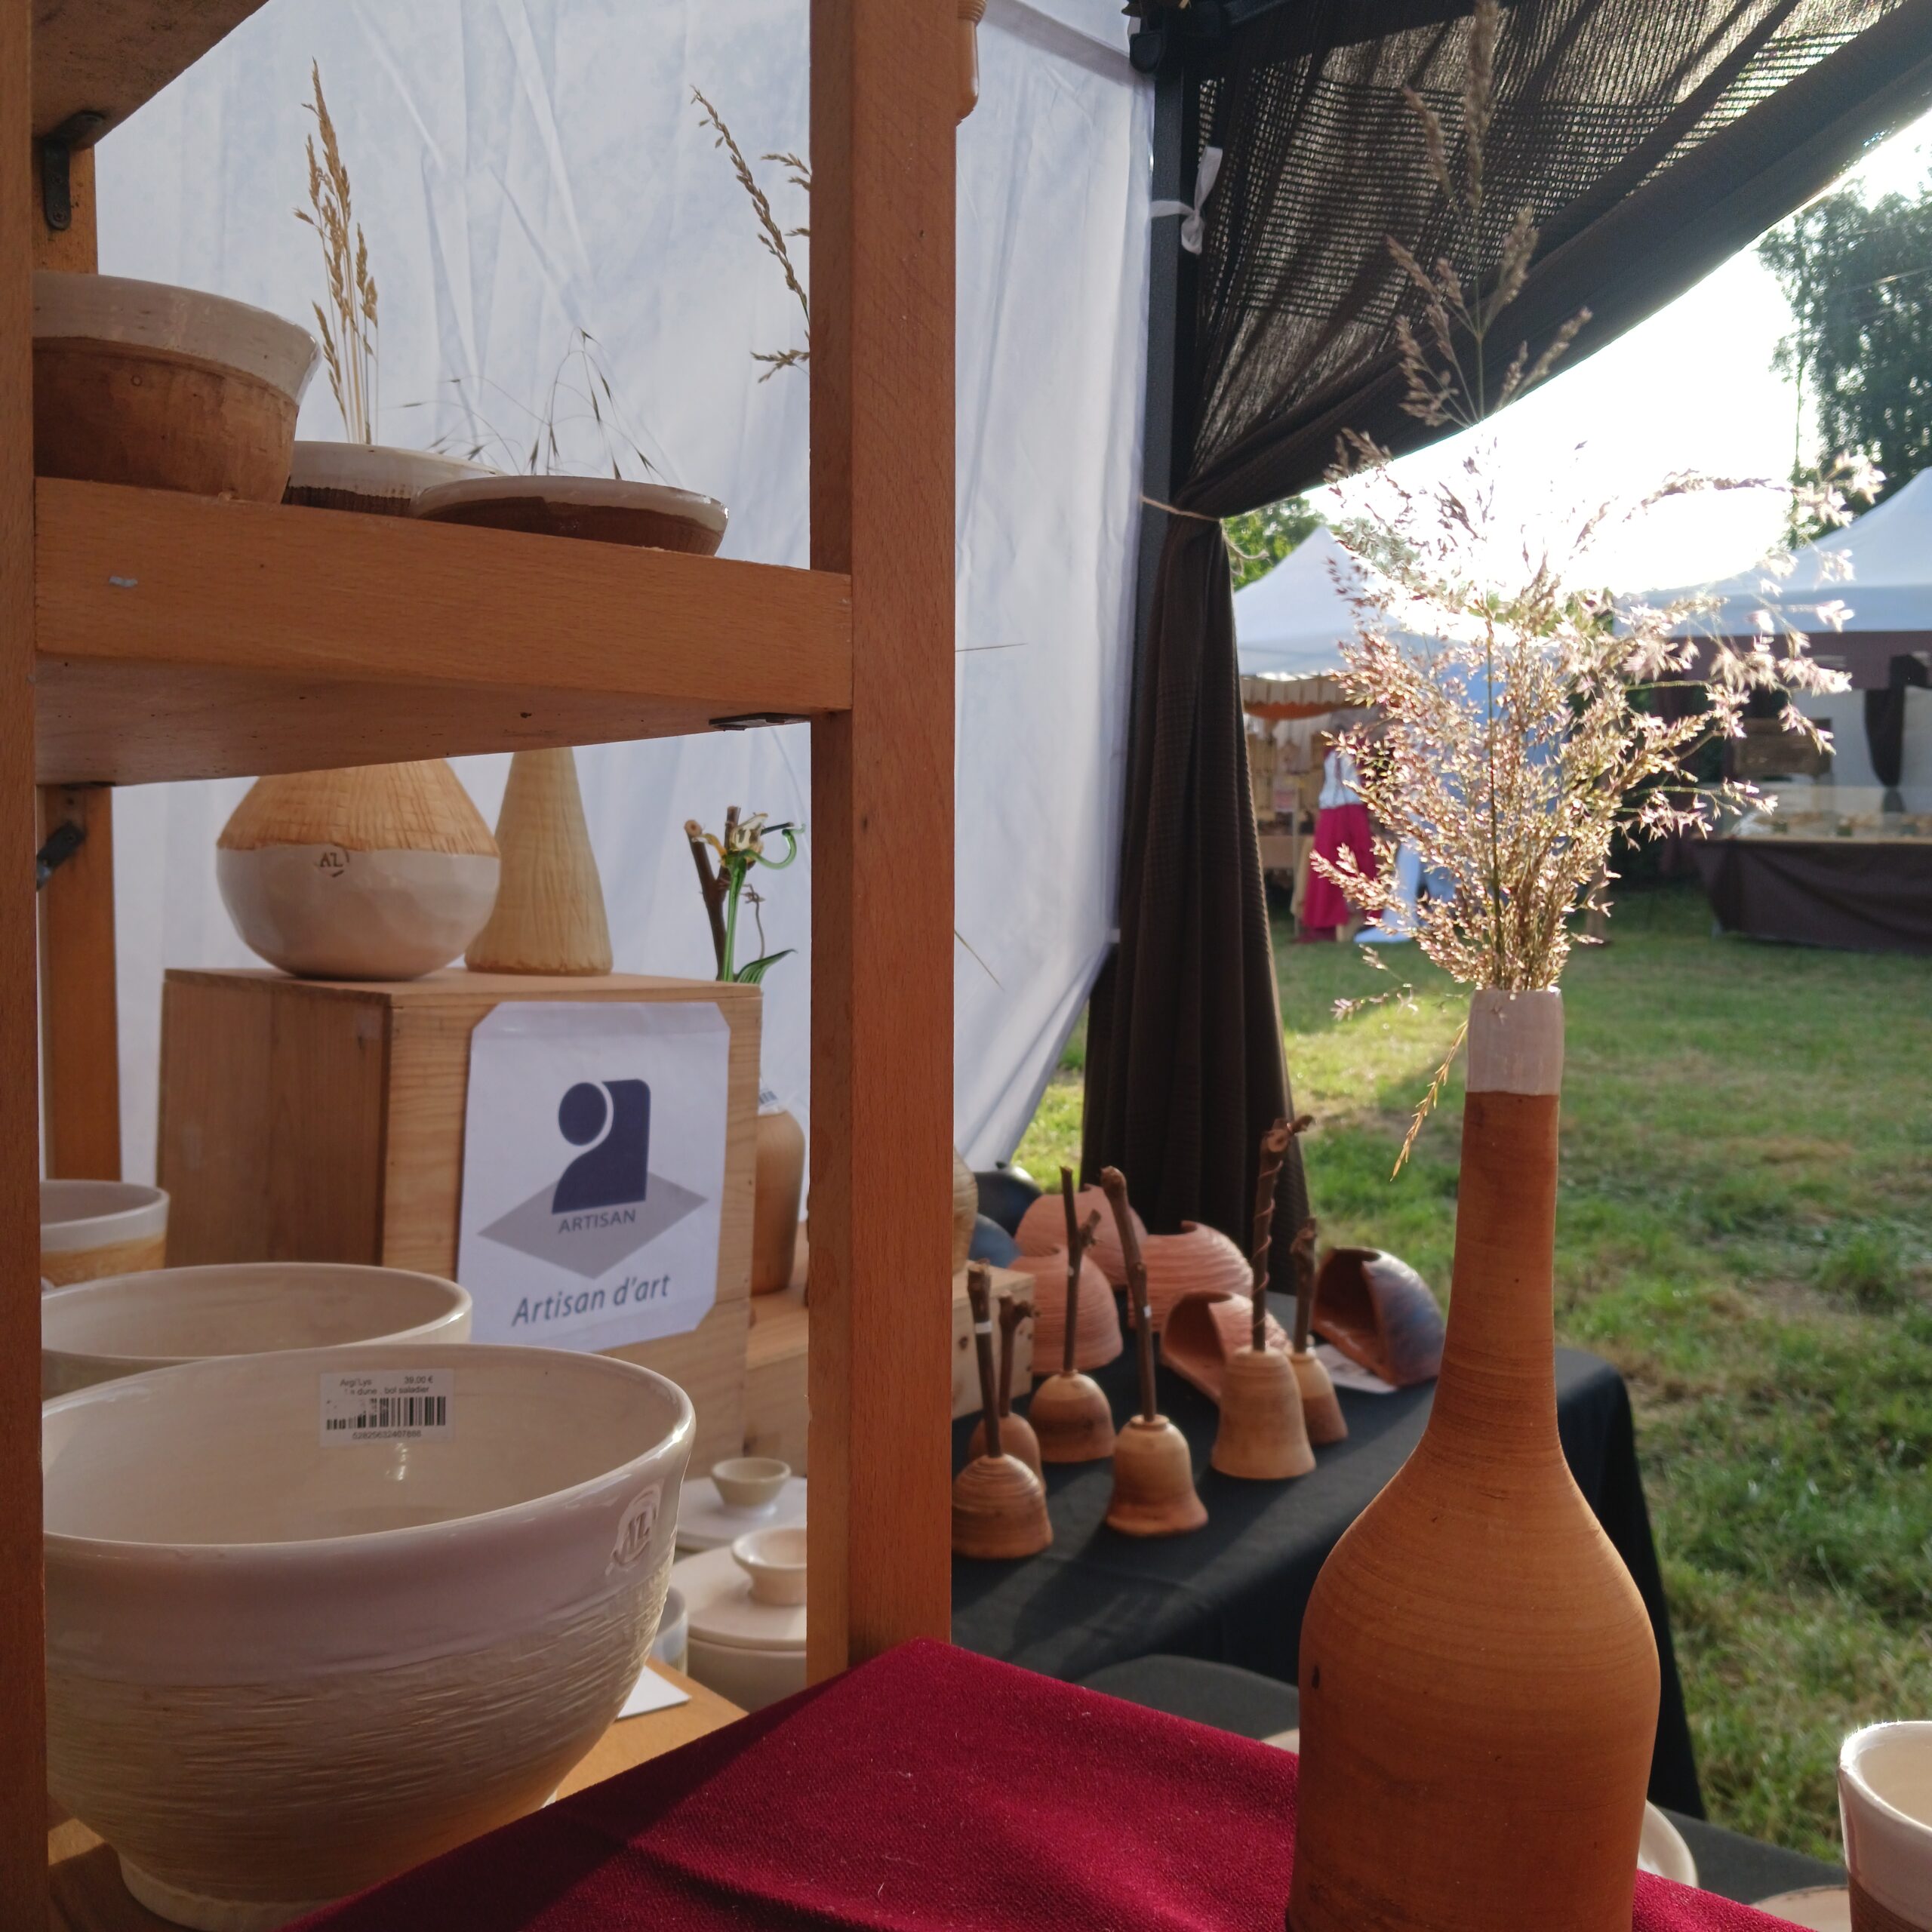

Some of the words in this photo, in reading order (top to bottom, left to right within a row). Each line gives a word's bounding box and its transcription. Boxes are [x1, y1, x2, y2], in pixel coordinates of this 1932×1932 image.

[558, 1209, 636, 1234] ARTISAN
[512, 1291, 605, 1327] Artisan
[614, 1274, 671, 1306] d'art
